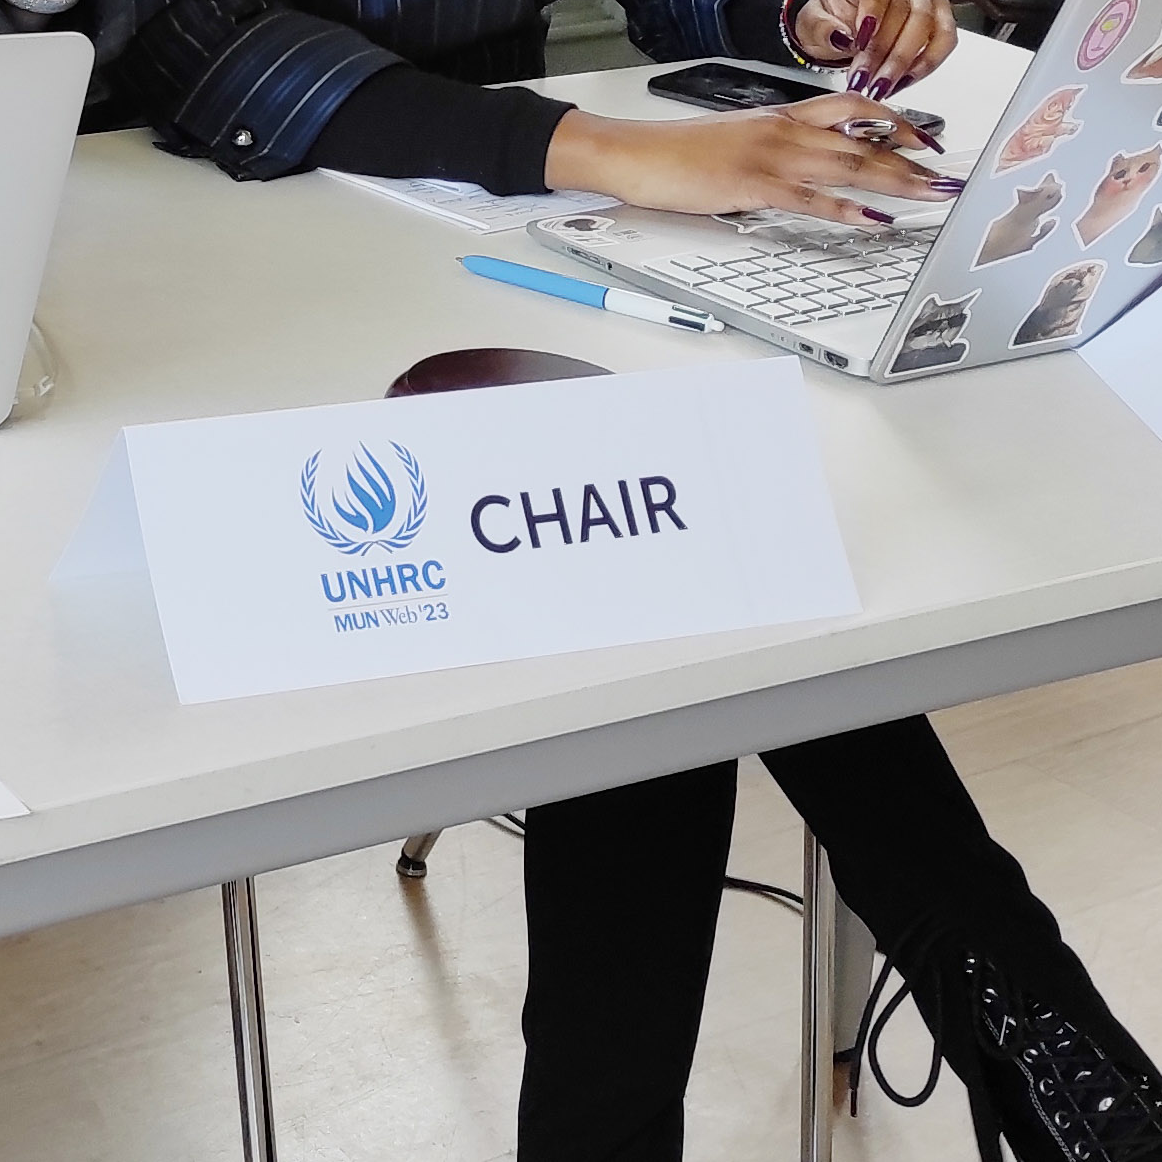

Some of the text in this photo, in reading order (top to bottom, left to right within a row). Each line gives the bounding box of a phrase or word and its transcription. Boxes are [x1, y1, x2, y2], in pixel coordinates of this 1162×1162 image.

[470, 475, 688, 554] CHAIR
[320, 559, 447, 603] UNHRC
[333, 602, 450, 633] MUN Web '23
